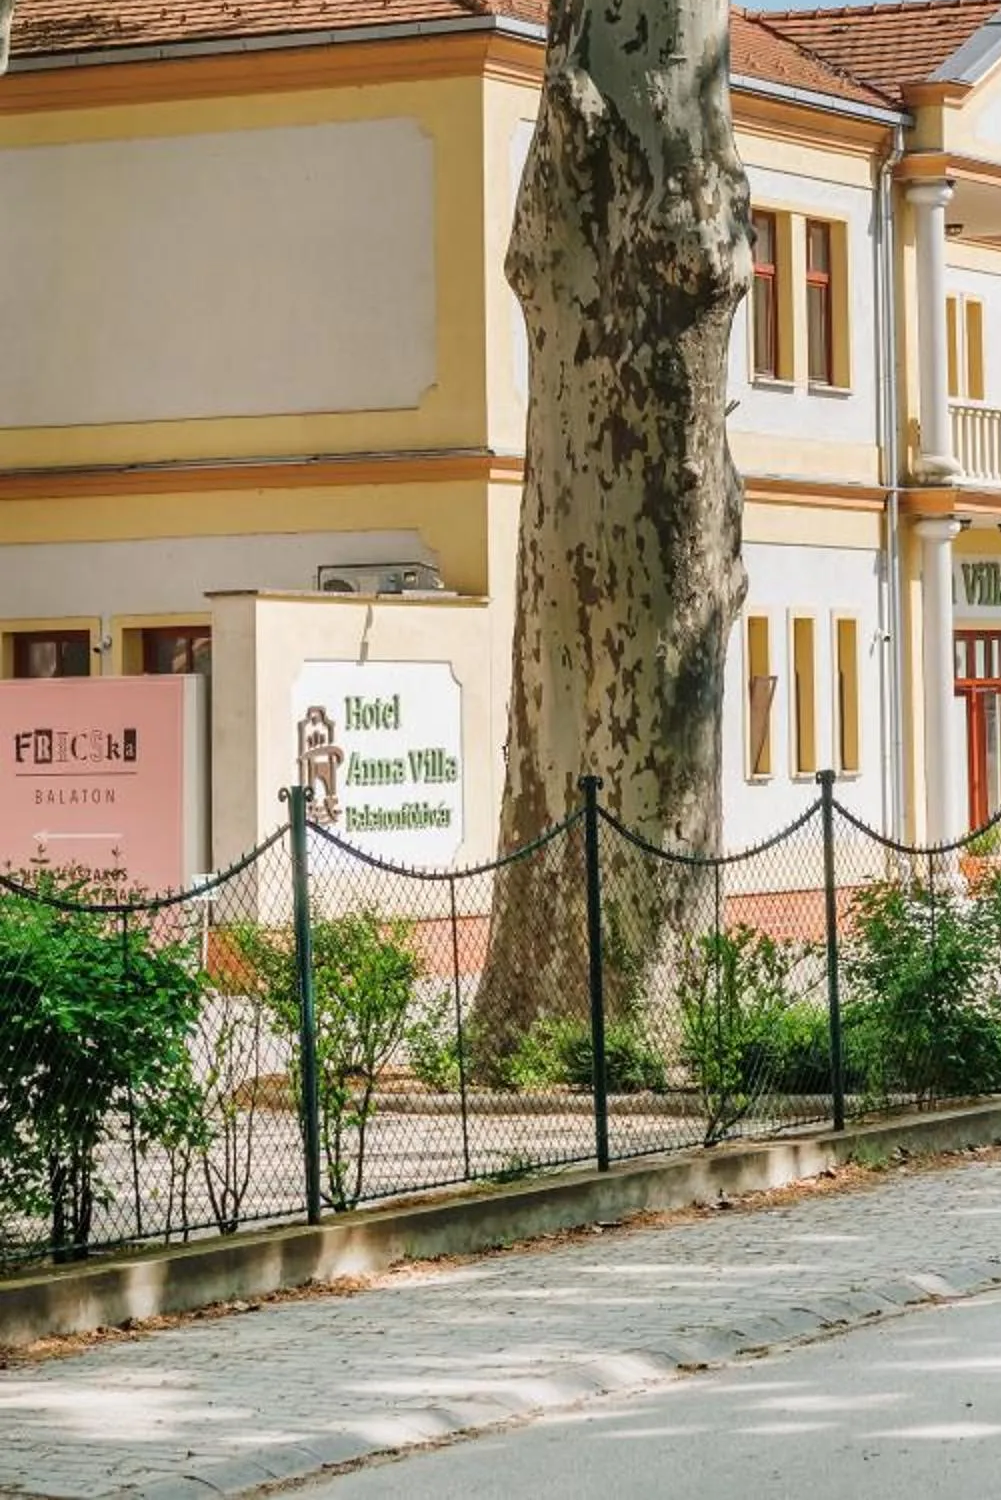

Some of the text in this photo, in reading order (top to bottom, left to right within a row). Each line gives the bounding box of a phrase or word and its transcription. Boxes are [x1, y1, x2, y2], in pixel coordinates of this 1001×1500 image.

[344, 694, 401, 731] Hotel
[346, 747, 458, 786] Anna Villa
[34, 788, 116, 804] BALATON
